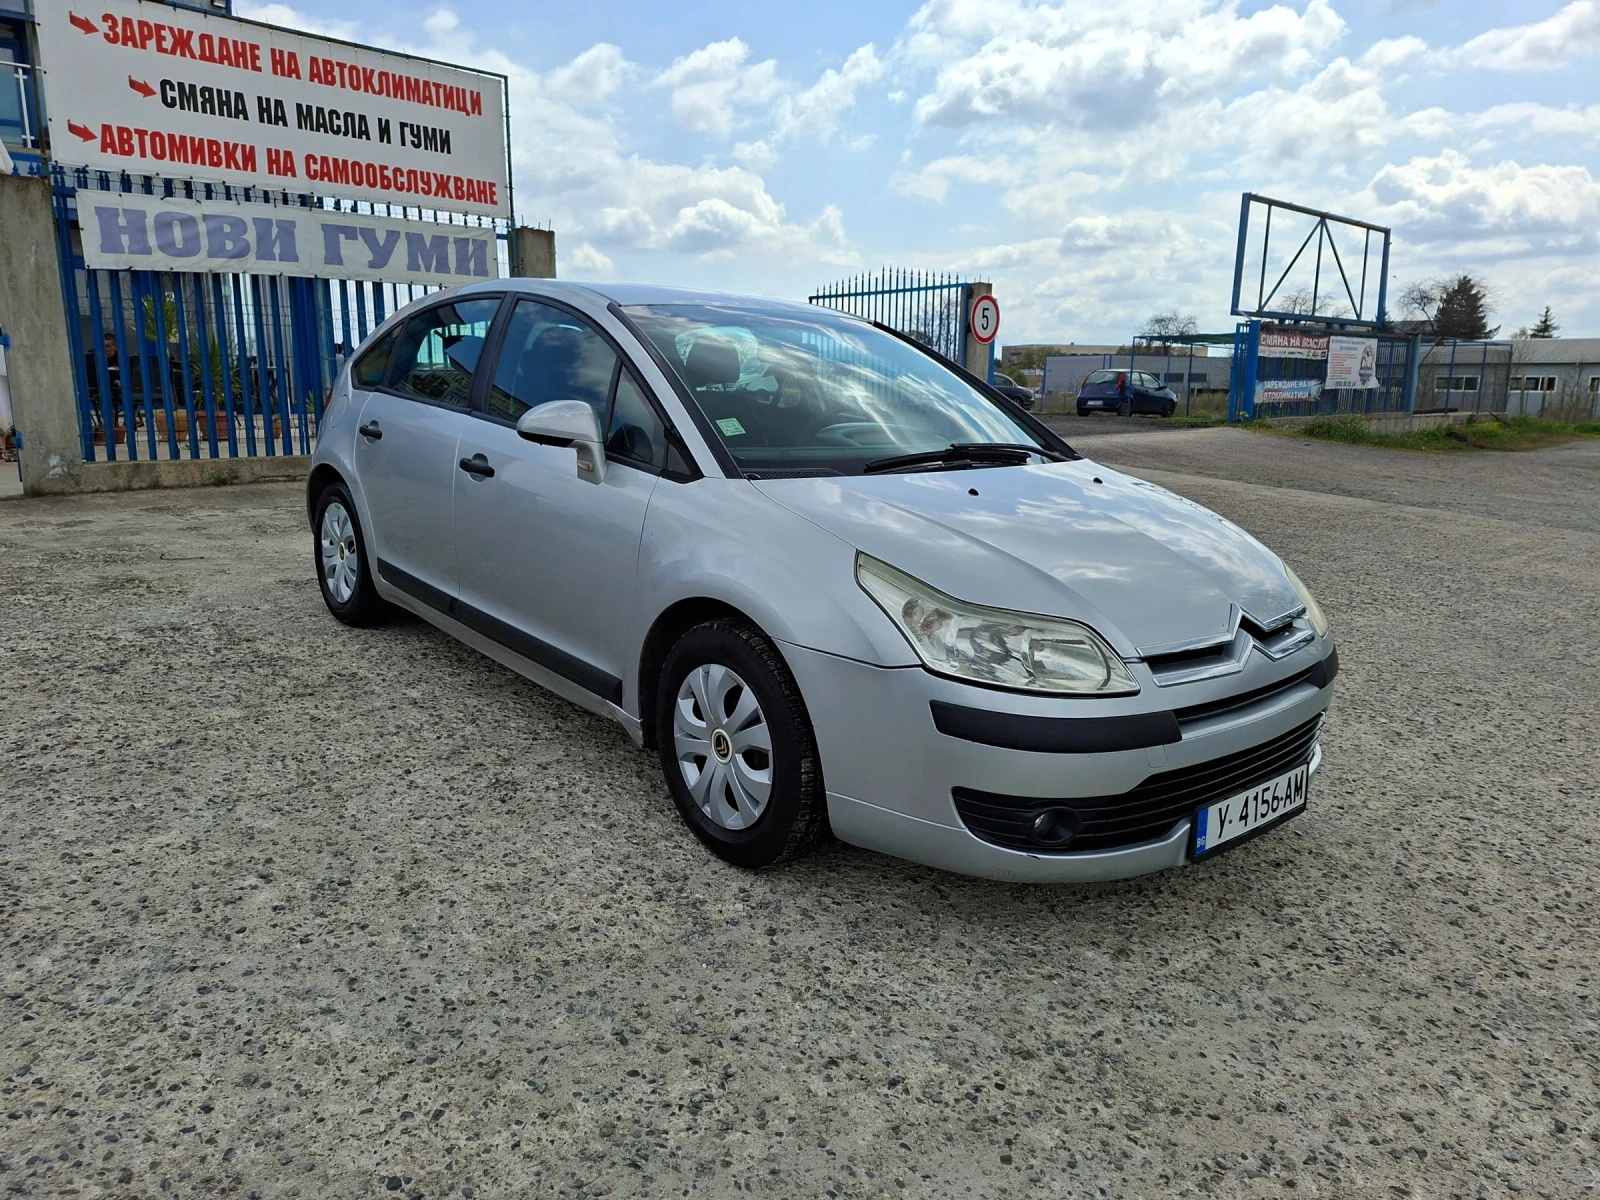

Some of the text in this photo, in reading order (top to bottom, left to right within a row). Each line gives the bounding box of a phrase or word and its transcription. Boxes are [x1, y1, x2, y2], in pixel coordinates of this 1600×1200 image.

[101, 13, 482, 116] ЗАРЕЖДАНЕ НА АВТОКЛИМАТИЦИ
[160, 79, 451, 154] СМЯНА НА МАСЛА И ГУМИ
[101, 123, 498, 206] АВТОМИВКИ НА САМООБСЛУЖВАНЕ
[94, 206, 489, 277] НОВИ ГУМИ
[981, 307, 990, 330] 5
[1261, 334, 1288, 346] СМЯНА
[1290, 336, 1300, 347] НА
[1263, 380, 1298, 389] ЗАРЕЖДАНЕ
[1239, 782, 1280, 827] 4156
[1284, 770, 1304, 808] AM
[1197, 836, 1206, 848] BG
